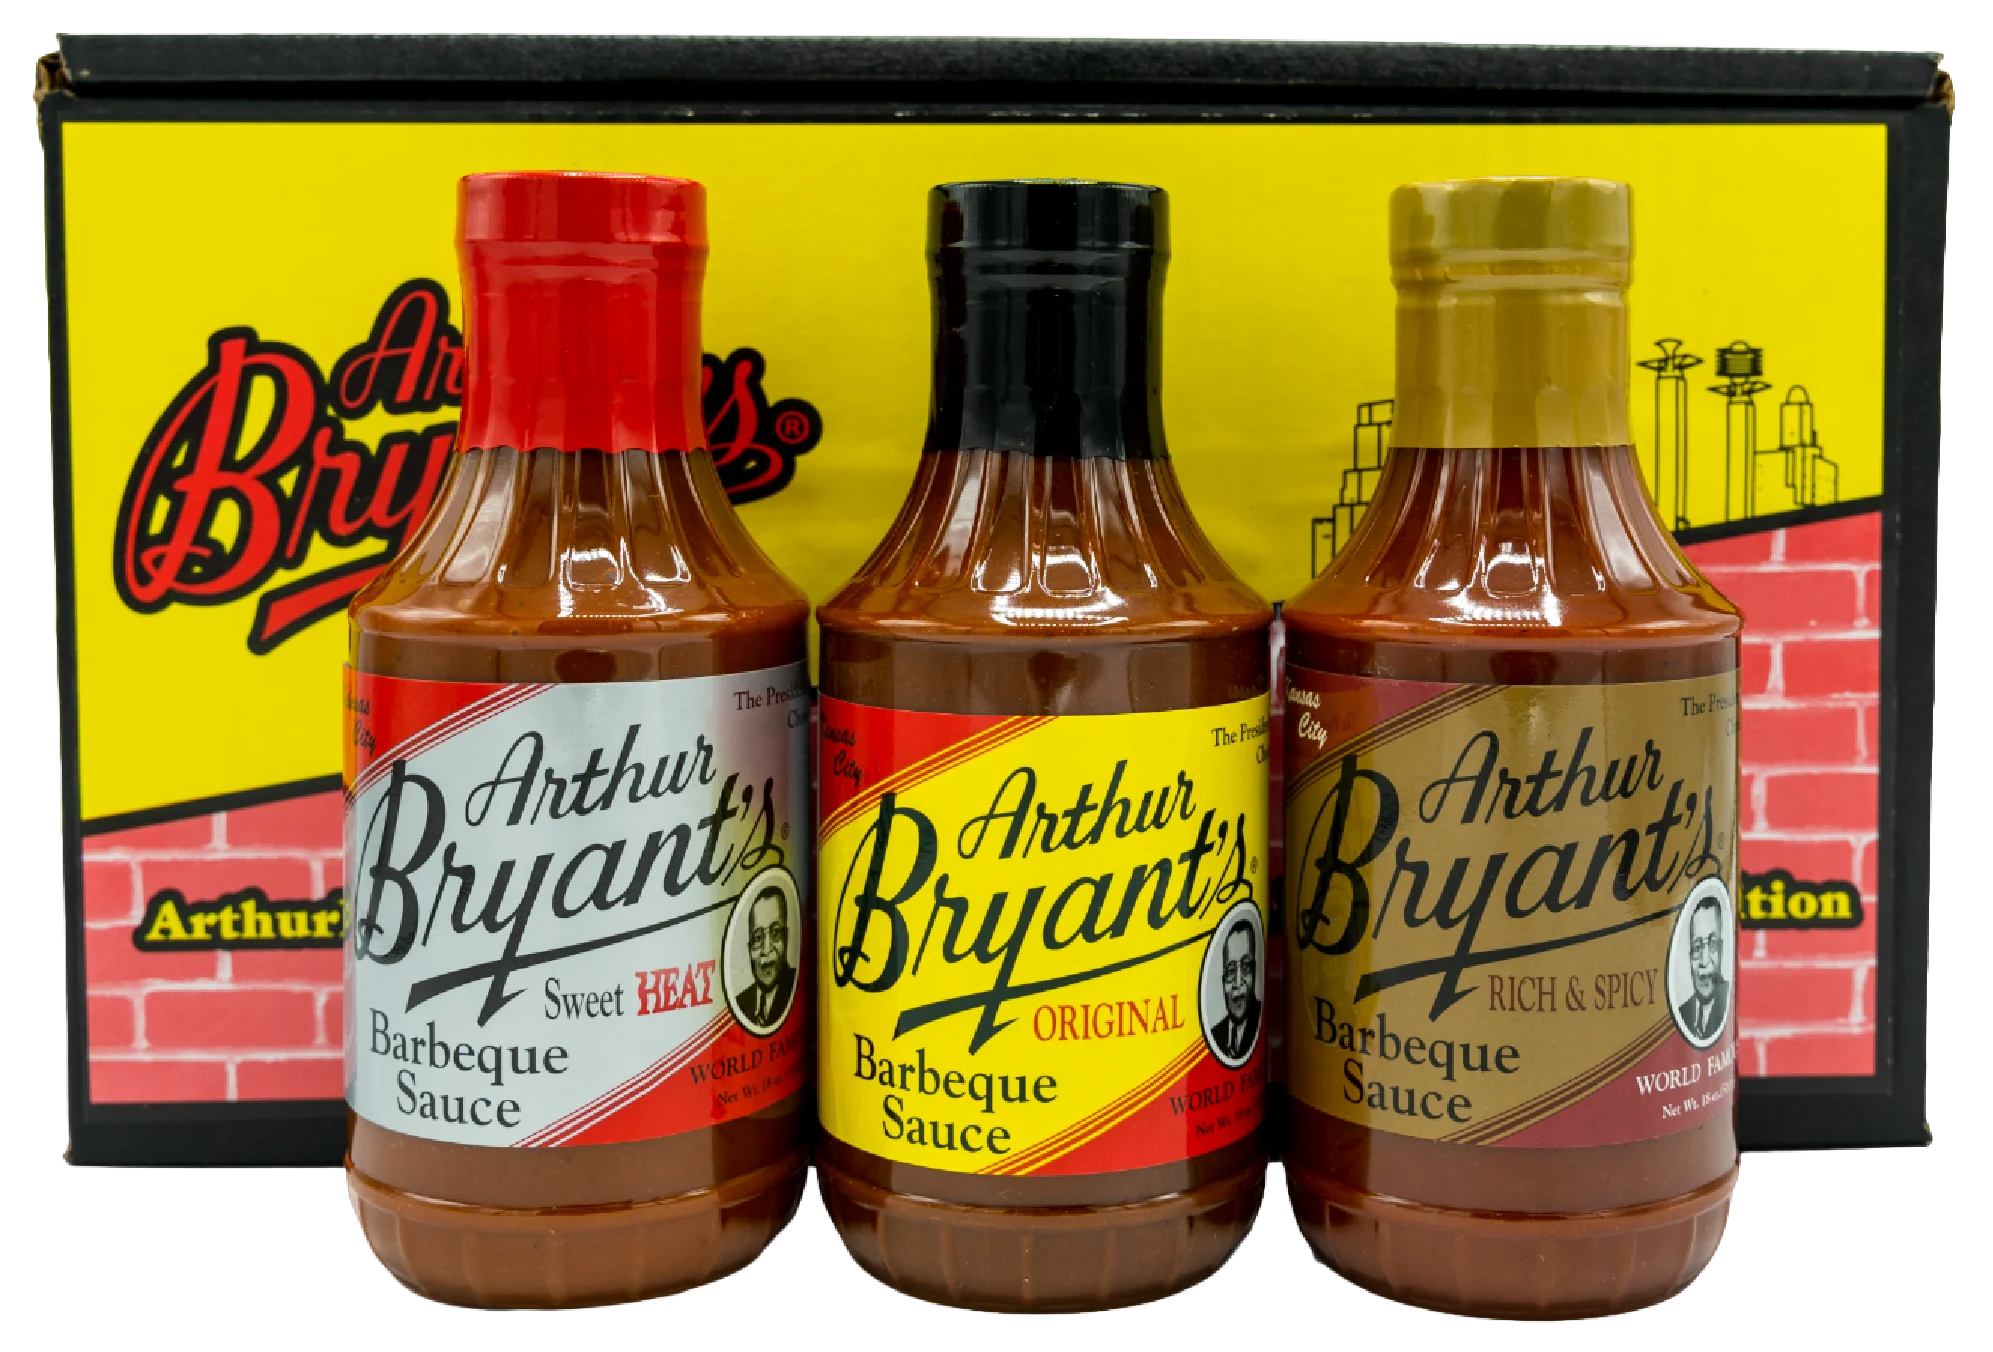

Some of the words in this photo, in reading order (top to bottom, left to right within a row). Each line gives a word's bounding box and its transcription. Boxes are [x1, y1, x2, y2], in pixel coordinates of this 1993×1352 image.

[733, 689, 762, 711] The
[1679, 695, 1706, 717] The
[1211, 727, 1237, 747] The
[1299, 711, 1327, 749] City
[465, 723, 717, 827] Arthur
[833, 750, 863, 788] City
[1419, 726, 1664, 824] Arthur
[957, 759, 1196, 859] Arthur
[544, 977, 625, 1020] Sweet
[635, 959, 717, 1017] HEAT
[1487, 974, 1557, 1013] RICH
[1565, 973, 1587, 1012] &
[1593, 967, 1659, 1011] SPICY
[1033, 994, 1186, 1042] ORIGINAL
[1314, 995, 1521, 1083] Barbeque
[370, 1008, 569, 1087] Barbeque
[690, 1049, 763, 1084] WORLD
[852, 1032, 1059, 1114] Barbeque
[1342, 1057, 1473, 1124] Sauce
[1636, 1063, 1701, 1095] WORLD
[395, 1069, 522, 1128] Sauce
[1169, 1080, 1235, 1117] WORLD
[1662, 1103, 1681, 1119] Net
[881, 1094, 1012, 1155] Sauce
